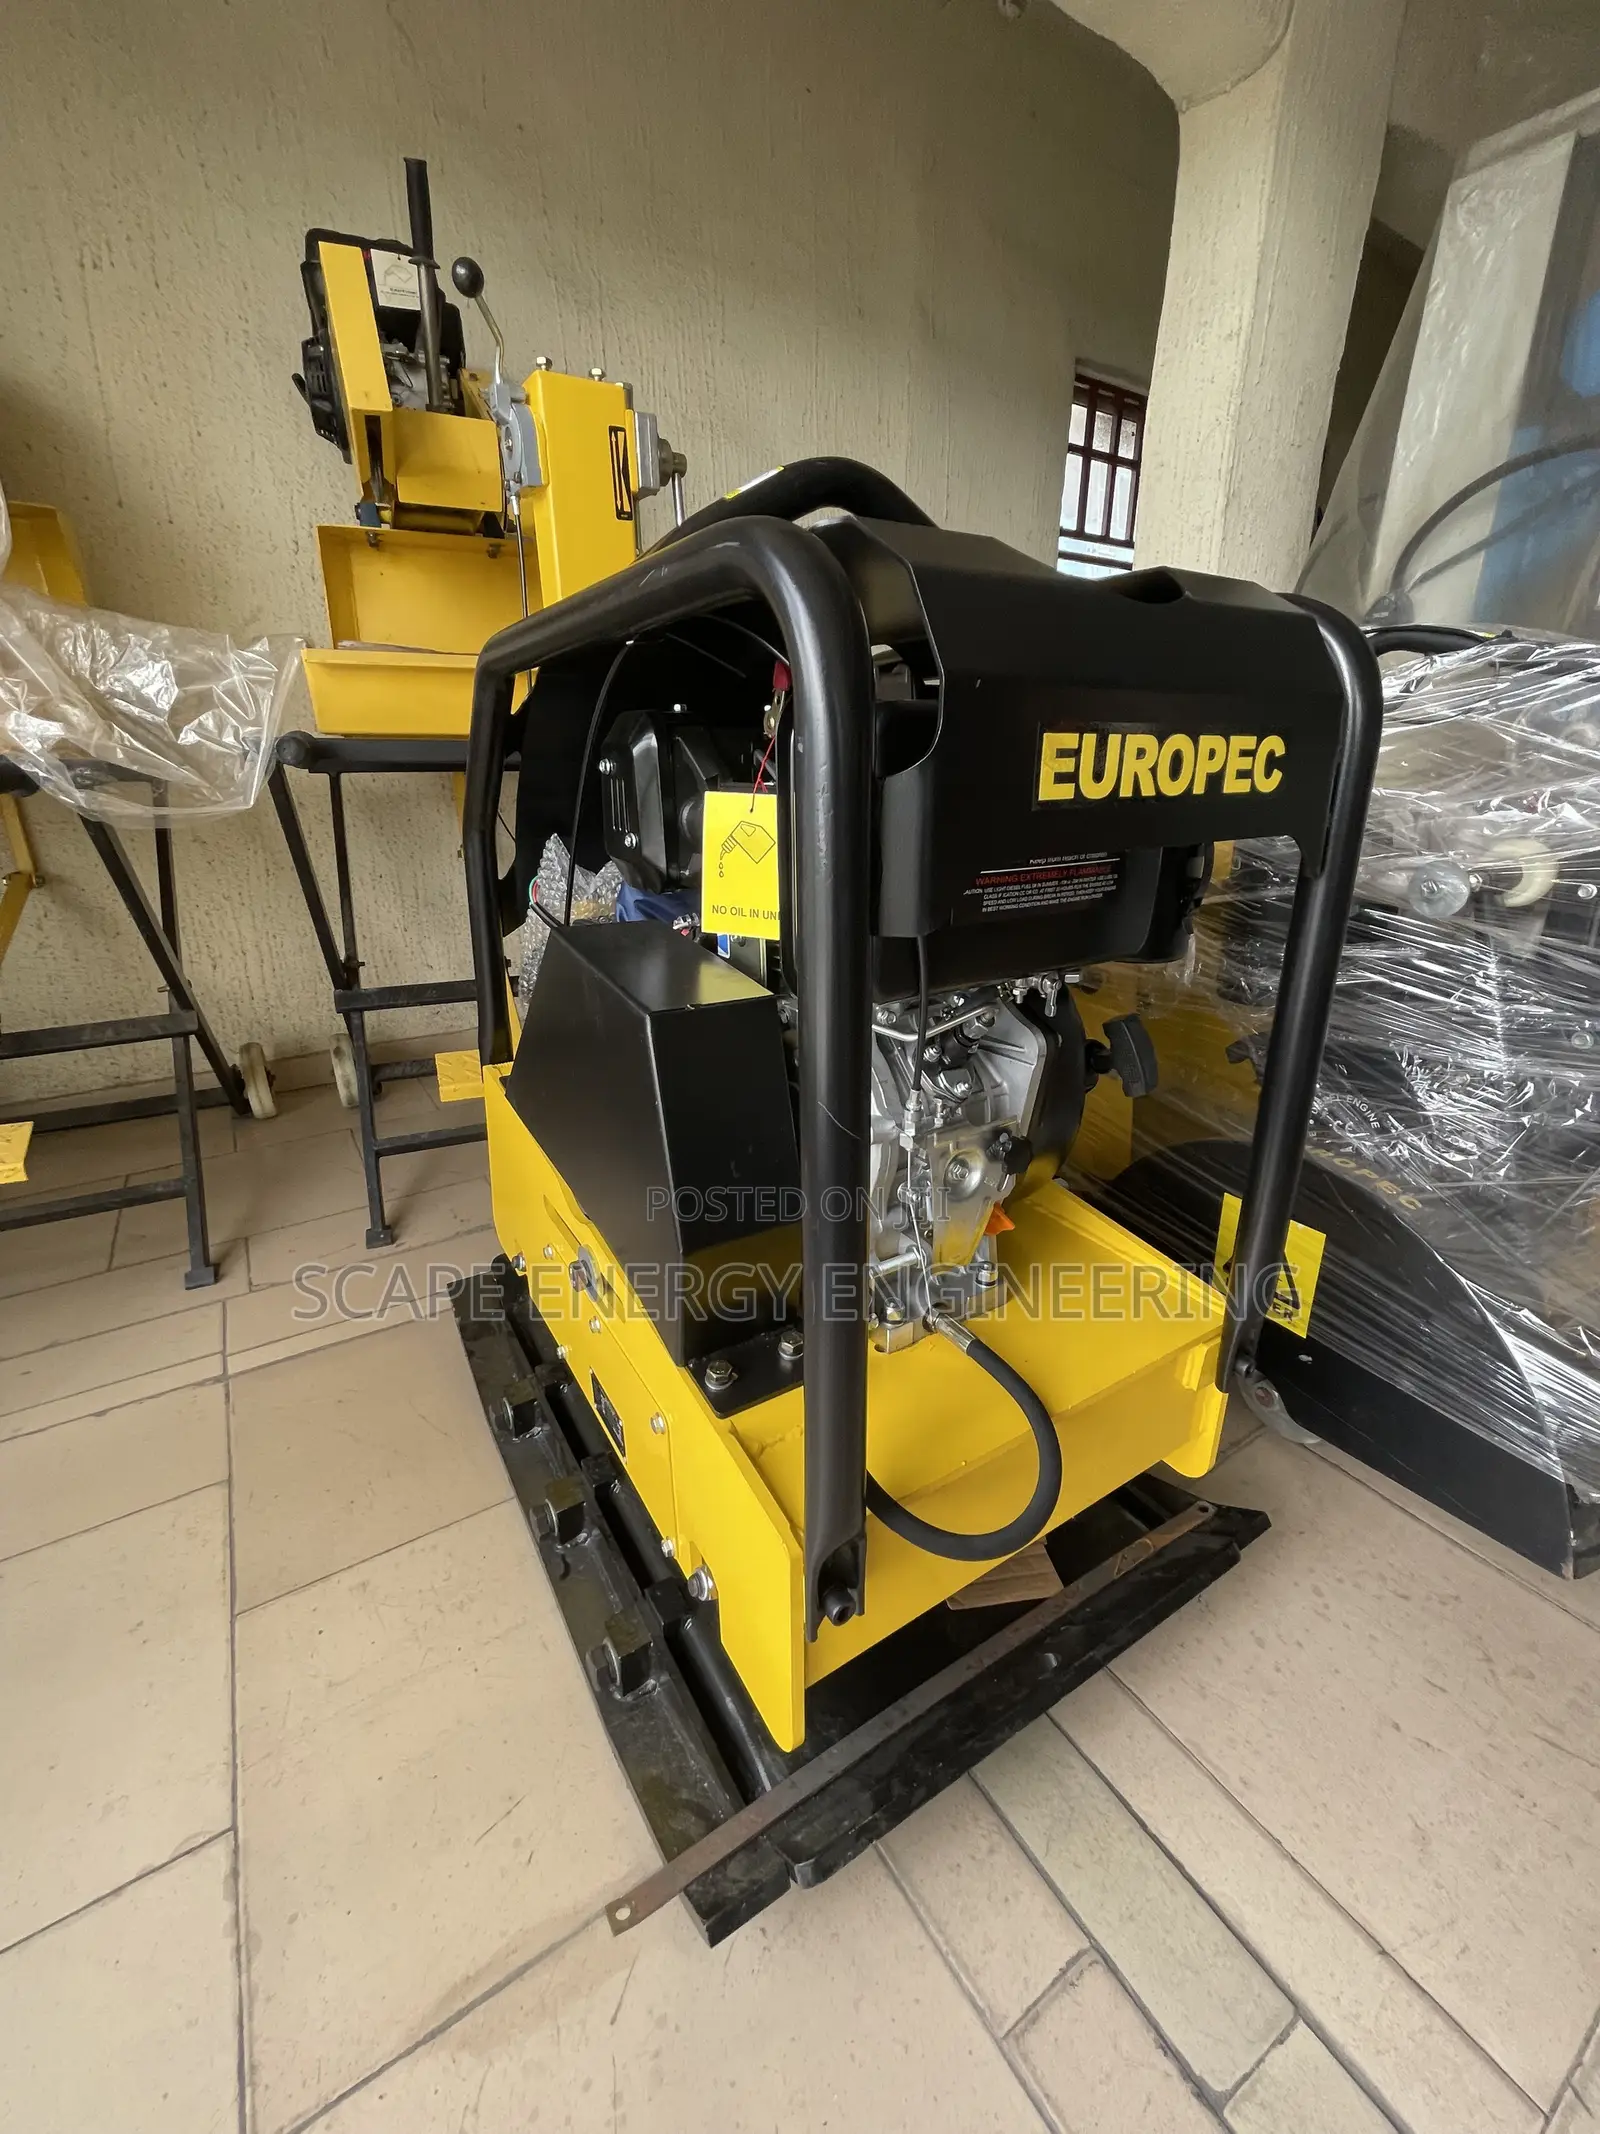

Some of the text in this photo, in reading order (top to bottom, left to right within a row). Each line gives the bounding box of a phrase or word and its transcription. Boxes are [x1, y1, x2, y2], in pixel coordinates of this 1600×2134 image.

[1038, 733, 1286, 800] EUROPEC
[976, 875, 1018, 886] WARNING
[1020, 870, 1068, 882] EXTREMELY
[712, 904, 727, 915] NO
[730, 906, 747, 917] OIL
[749, 908, 759, 919] IN
[1346, 1094, 1380, 1129] ENGINE
[1308, 1146, 1422, 1210] ROPEC
